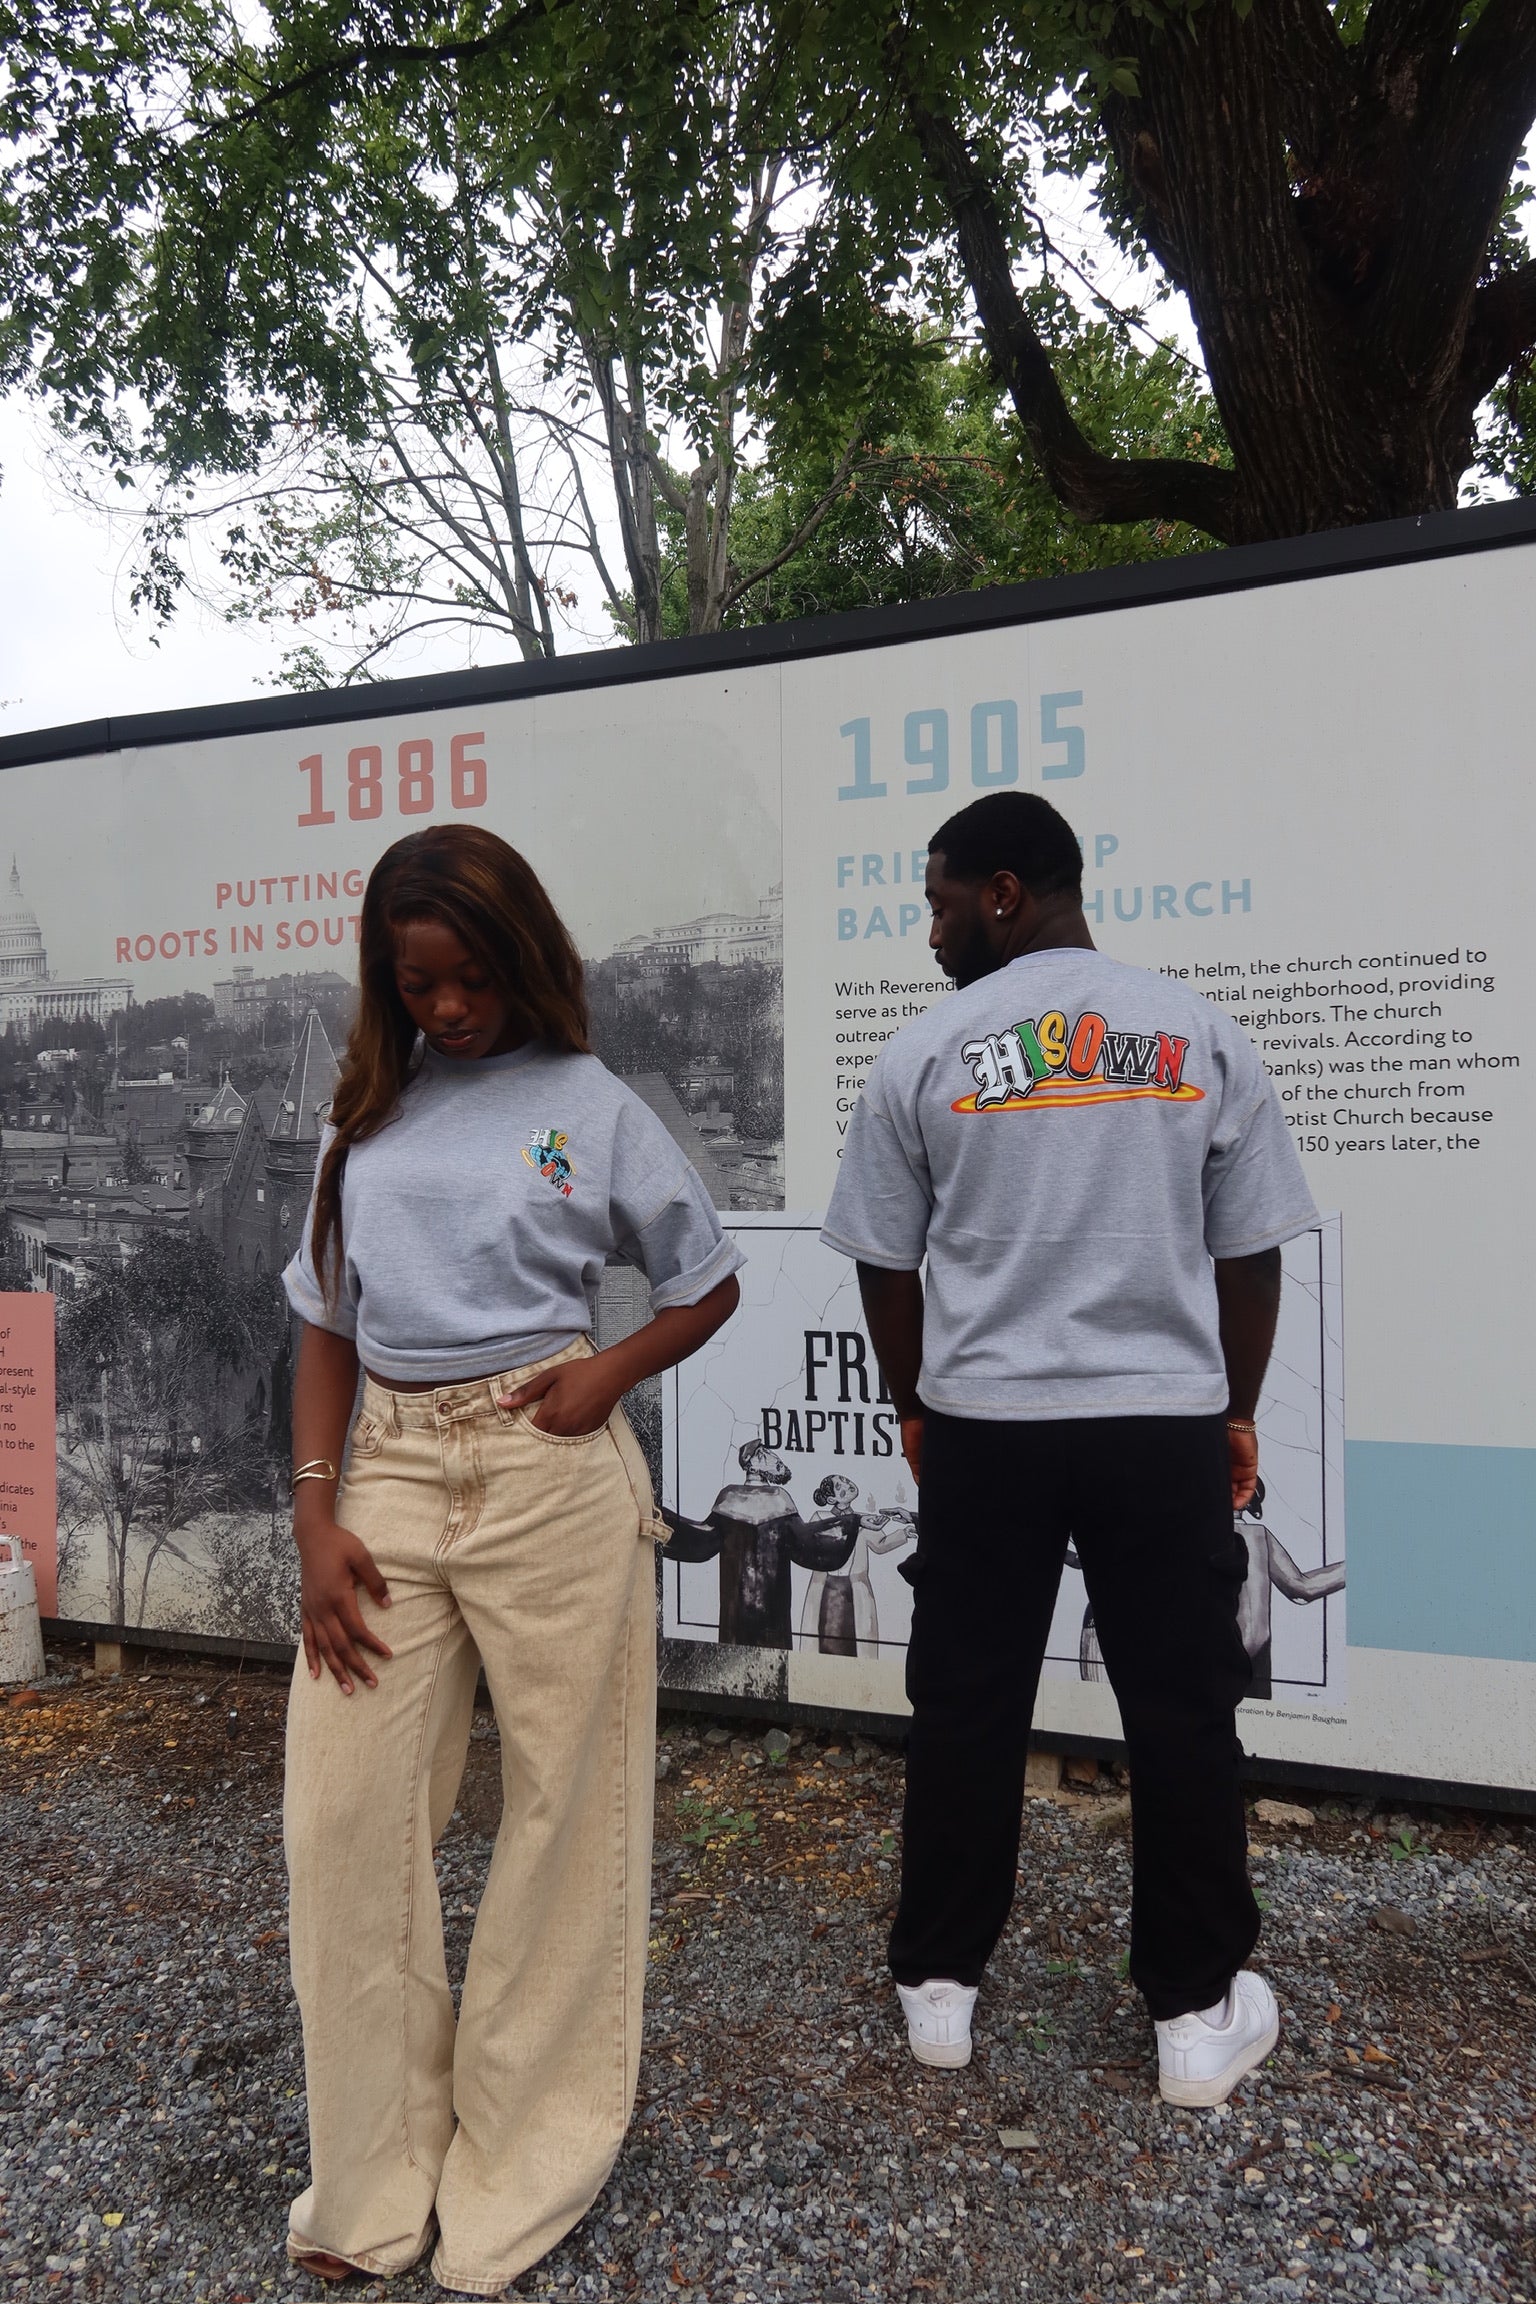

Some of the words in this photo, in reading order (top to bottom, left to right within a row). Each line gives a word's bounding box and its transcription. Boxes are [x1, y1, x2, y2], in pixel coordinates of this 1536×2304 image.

[837, 690, 1086, 801] 1905
[297, 731, 488, 827] 1886
[216, 869, 365, 909] PUTTING
[837, 902, 933, 941] BAP
[116, 928, 218, 963] ROOTS
[230, 924, 263, 954] IN
[1195, 962, 1246, 978] helm,
[1250, 959, 1280, 975] the
[1286, 954, 1352, 973] church
[1358, 947, 1459, 969] continued
[1466, 949, 1487, 963] to
[835, 981, 874, 997] With
[880, 977, 956, 995] Reverend
[1199, 985, 1247, 1002] ntial
[1252, 977, 1394, 1003] neighborhood,
[1399, 973, 1495, 997] providing
[835, 1007, 877, 1020] serve
[881, 1007, 898, 1018] as
[902, 1002, 928, 1017] the
[1329, 1004, 1368, 1022] The
[1373, 1000, 1442, 1020] church
[835, 1026, 900, 1043] outreac
[1263, 1032, 1339, 1050] revivals.
[1344, 1028, 1446, 1048] According
[1452, 1029, 1473, 1044] to
[1329, 1060, 1365, 1074] was
[1371, 1056, 1403, 1072] the
[1409, 1057, 1451, 1071] man
[1456, 1052, 1520, 1070] whom
[1281, 1084, 1303, 1101] of
[1306, 1084, 1338, 1100] the
[1344, 1082, 1411, 1100] church
[1418, 1080, 1465, 1098] from
[1333, 1107, 1404, 1126] Church
[1410, 1107, 1493, 1124] because
[1297, 1135, 1329, 1152] 150
[1335, 1139, 1386, 1156] years
[1391, 1134, 1442, 1153] later,
[1447, 1133, 1480, 1150] the
[761, 1408, 906, 1458] BAPTIS
[18, 1438, 36, 1451] the
